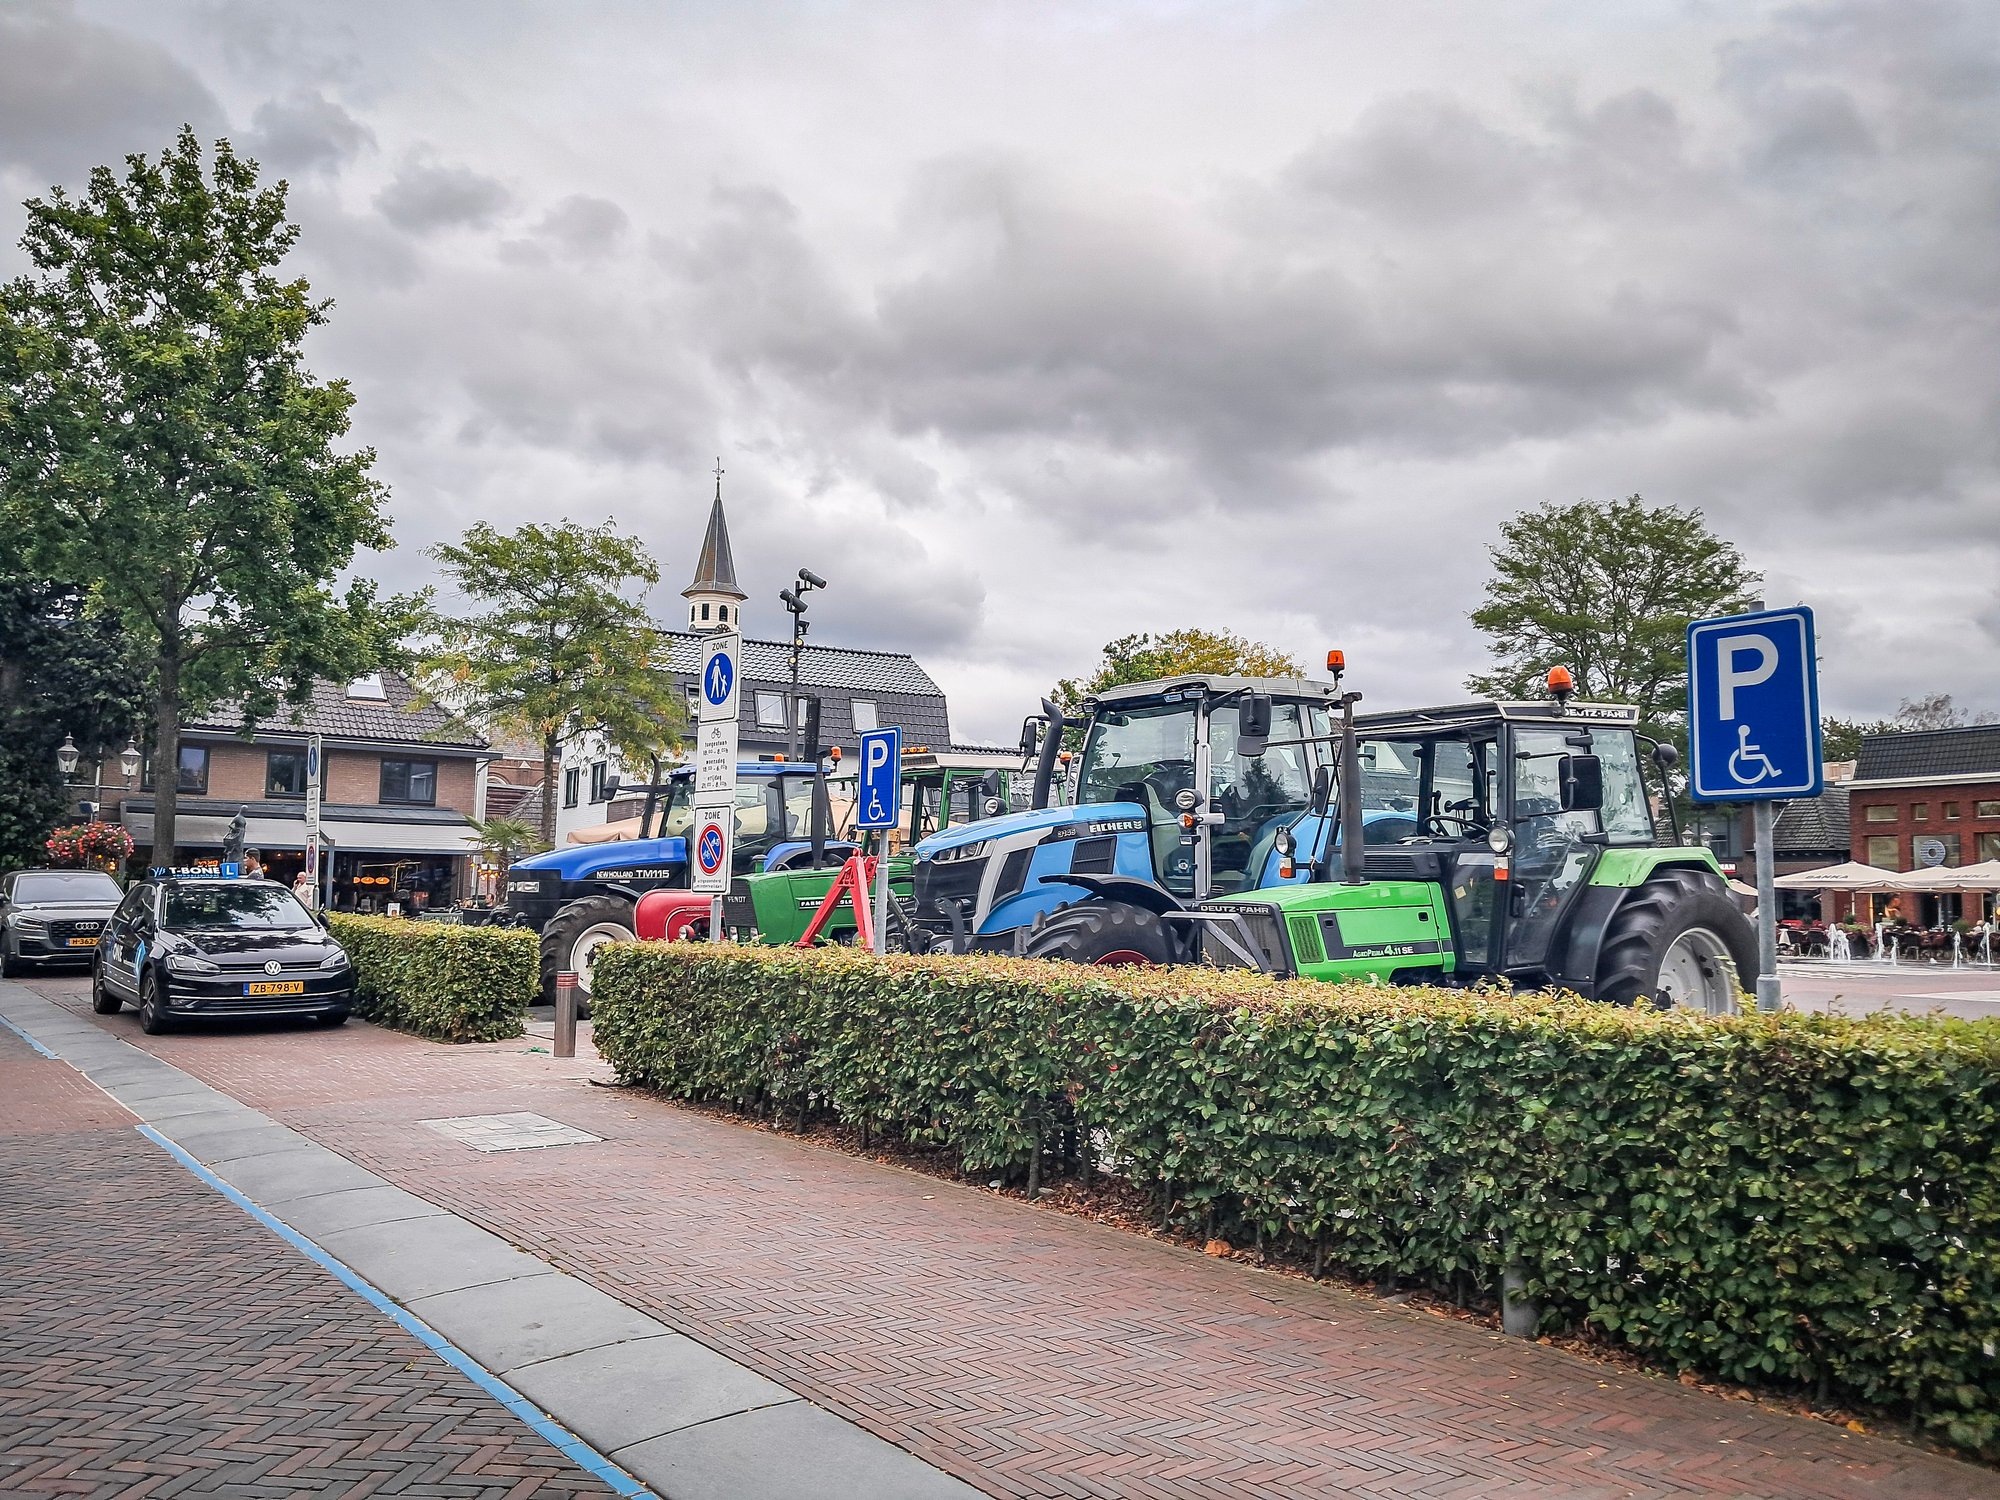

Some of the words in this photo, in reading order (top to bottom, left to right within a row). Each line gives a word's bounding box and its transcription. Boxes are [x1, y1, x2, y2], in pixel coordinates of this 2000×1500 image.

[711, 641, 728, 651] ZONE
[1717, 634, 1778, 720] P
[867, 739, 888, 785] P
[705, 811, 720, 819] ZONE
[1089, 821, 1132, 833] EICHER
[168, 866, 220, 874] T-BONE
[226, 865, 234, 875] L
[596, 871, 608, 879] NEW
[635, 869, 670, 878] TM115
[1200, 905, 1269, 913] DEUTZ-FAHR
[1402, 946, 1414, 954] SE
[253, 983, 300, 994] ZB-798-V
